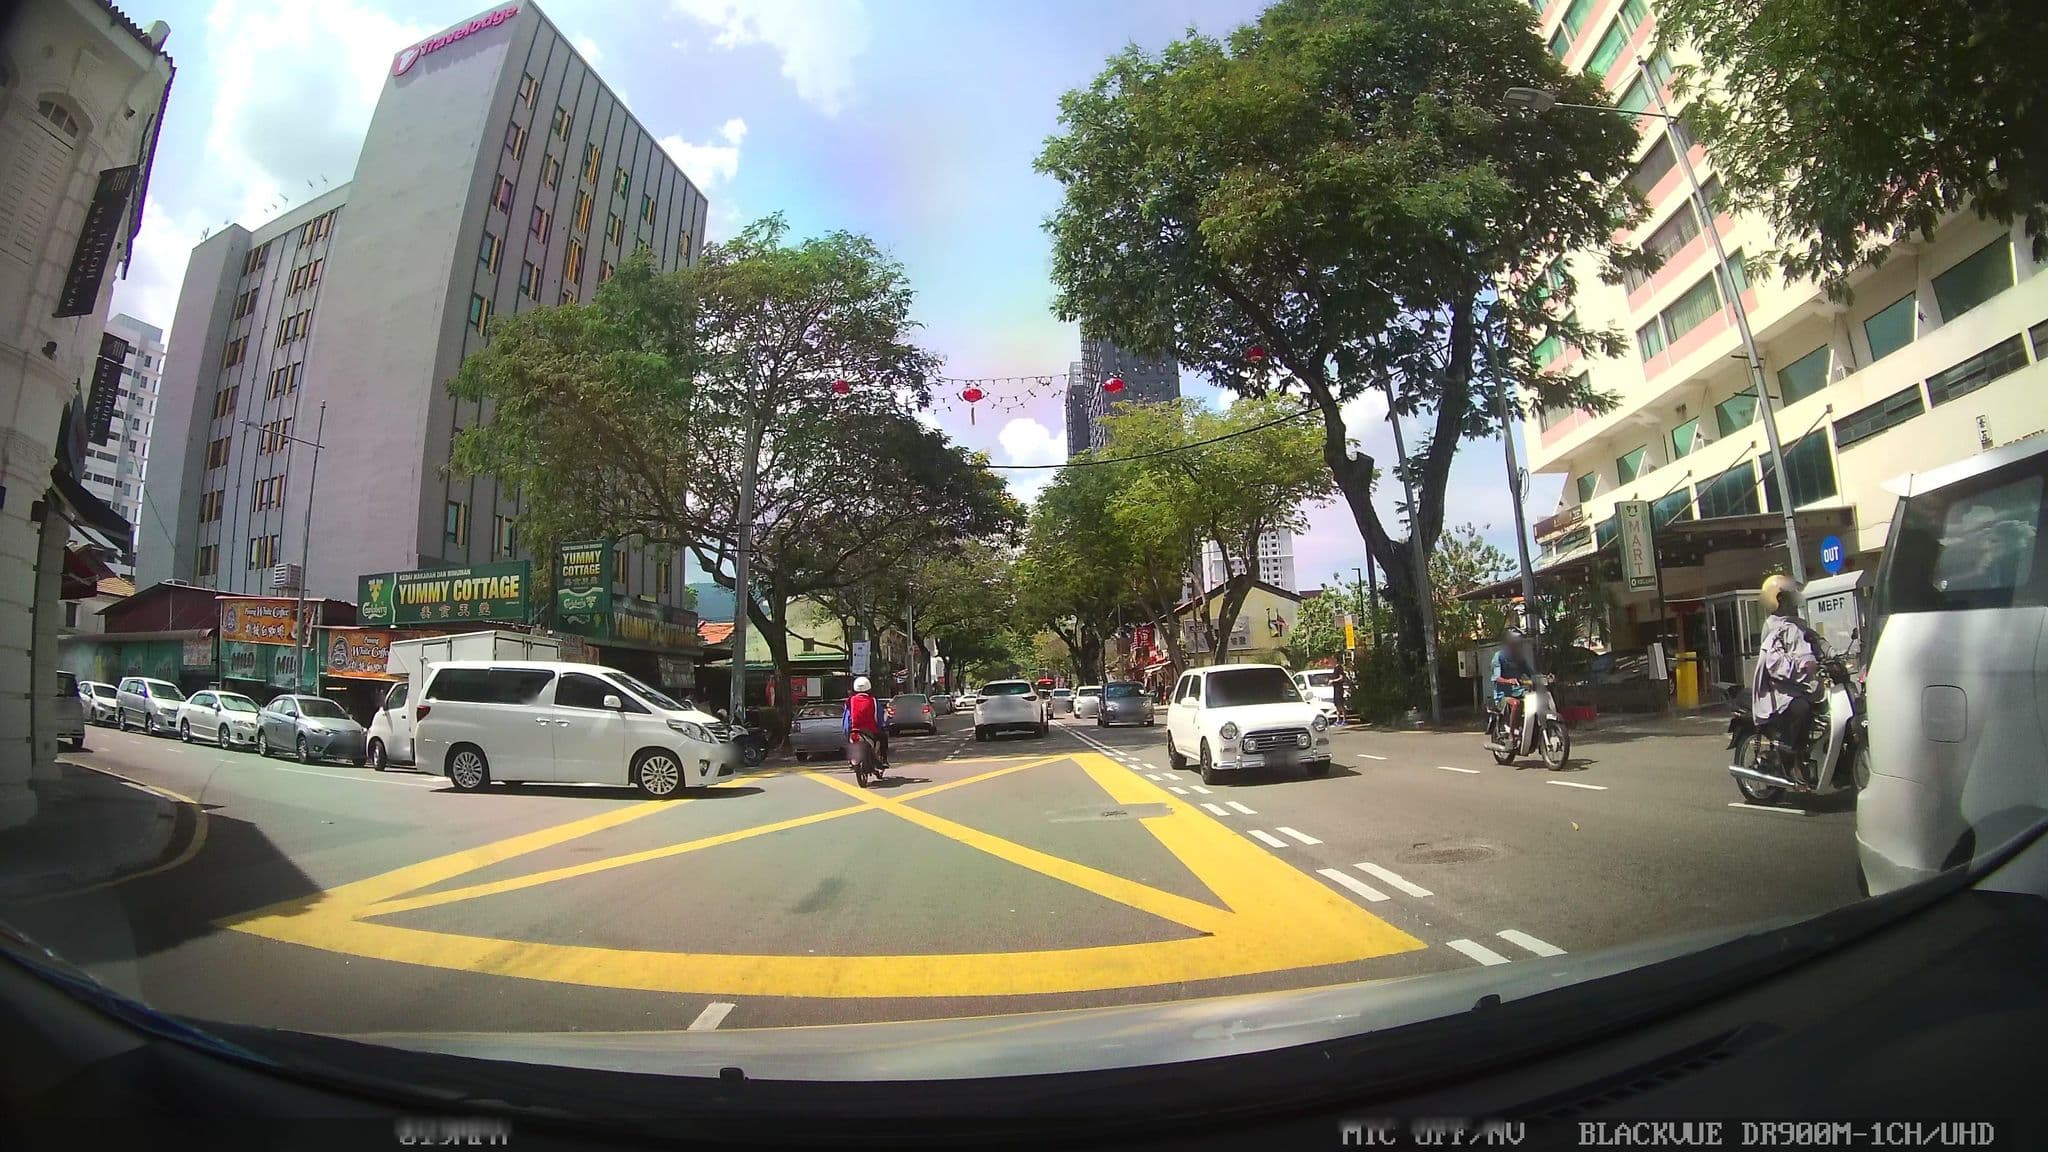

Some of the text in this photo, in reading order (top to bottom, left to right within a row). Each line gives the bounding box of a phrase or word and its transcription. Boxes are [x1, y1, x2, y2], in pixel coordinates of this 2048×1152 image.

[420, 5, 518, 56] Travelodge
[1628, 521, 1644, 575] MART
[1823, 546, 1839, 563] OUT
[562, 550, 602, 565] YUMMY
[562, 564, 601, 576] COTTAGE
[399, 575, 520, 605] YUMMY COTTAGE
[363, 602, 388, 619] Carlsberg
